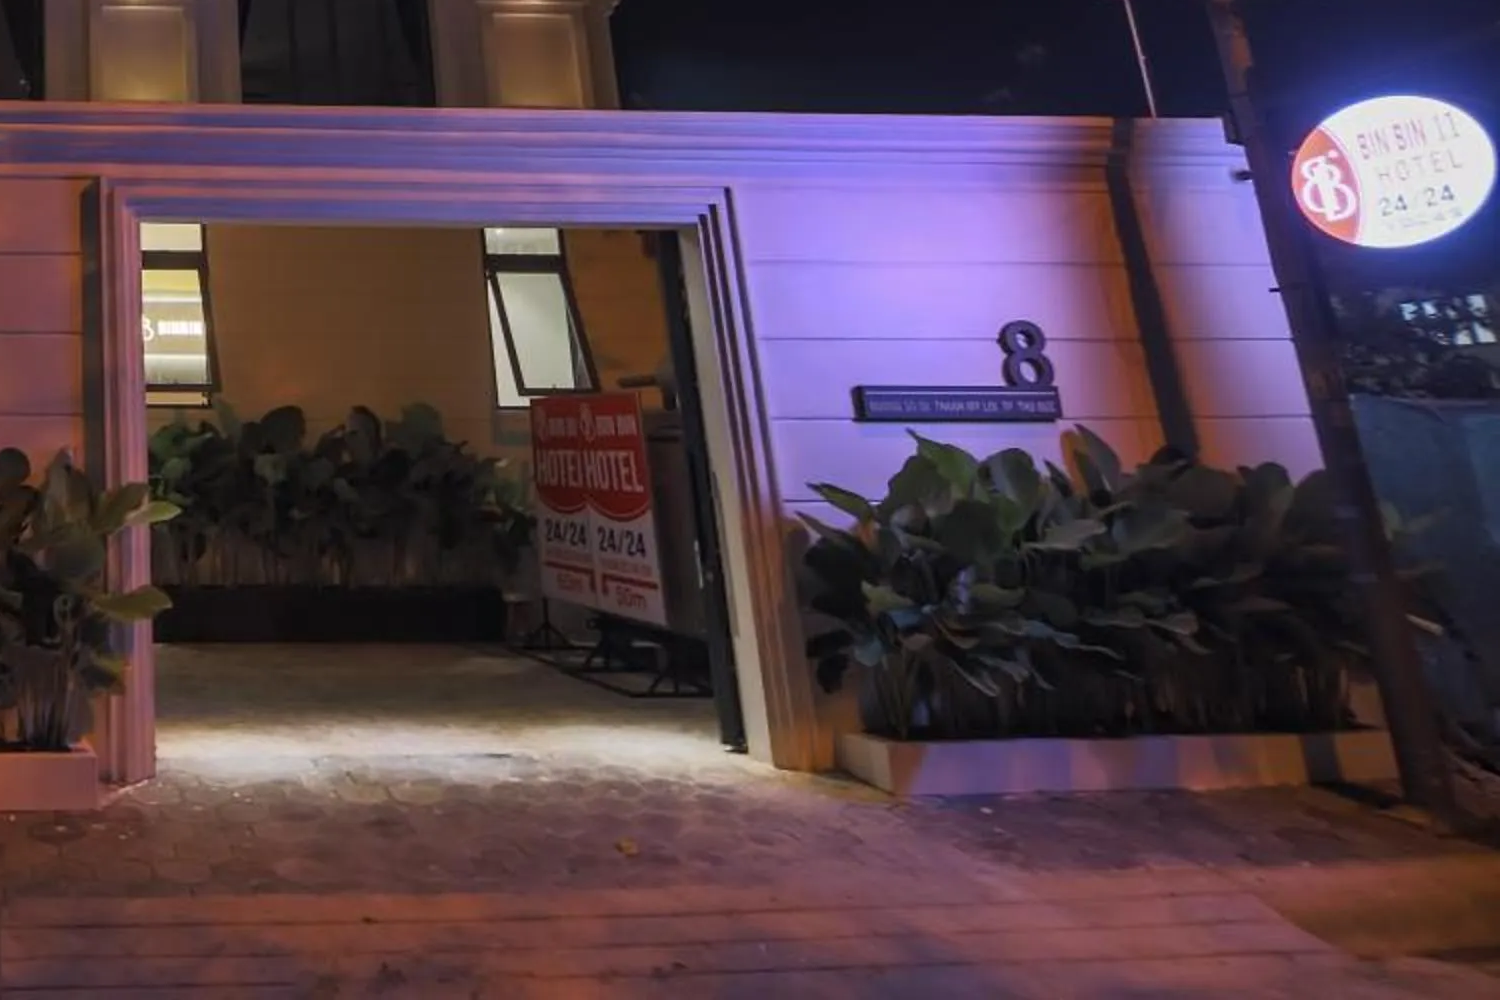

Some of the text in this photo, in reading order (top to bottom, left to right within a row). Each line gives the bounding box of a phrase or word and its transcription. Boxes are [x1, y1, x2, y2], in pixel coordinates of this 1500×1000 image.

[1376, 148, 1464, 182] HOTEL
[997, 319, 1055, 387] 8
[584, 450, 645, 494] HOTEL
[544, 518, 588, 547] 24/24
[597, 525, 647, 559] 24/24
